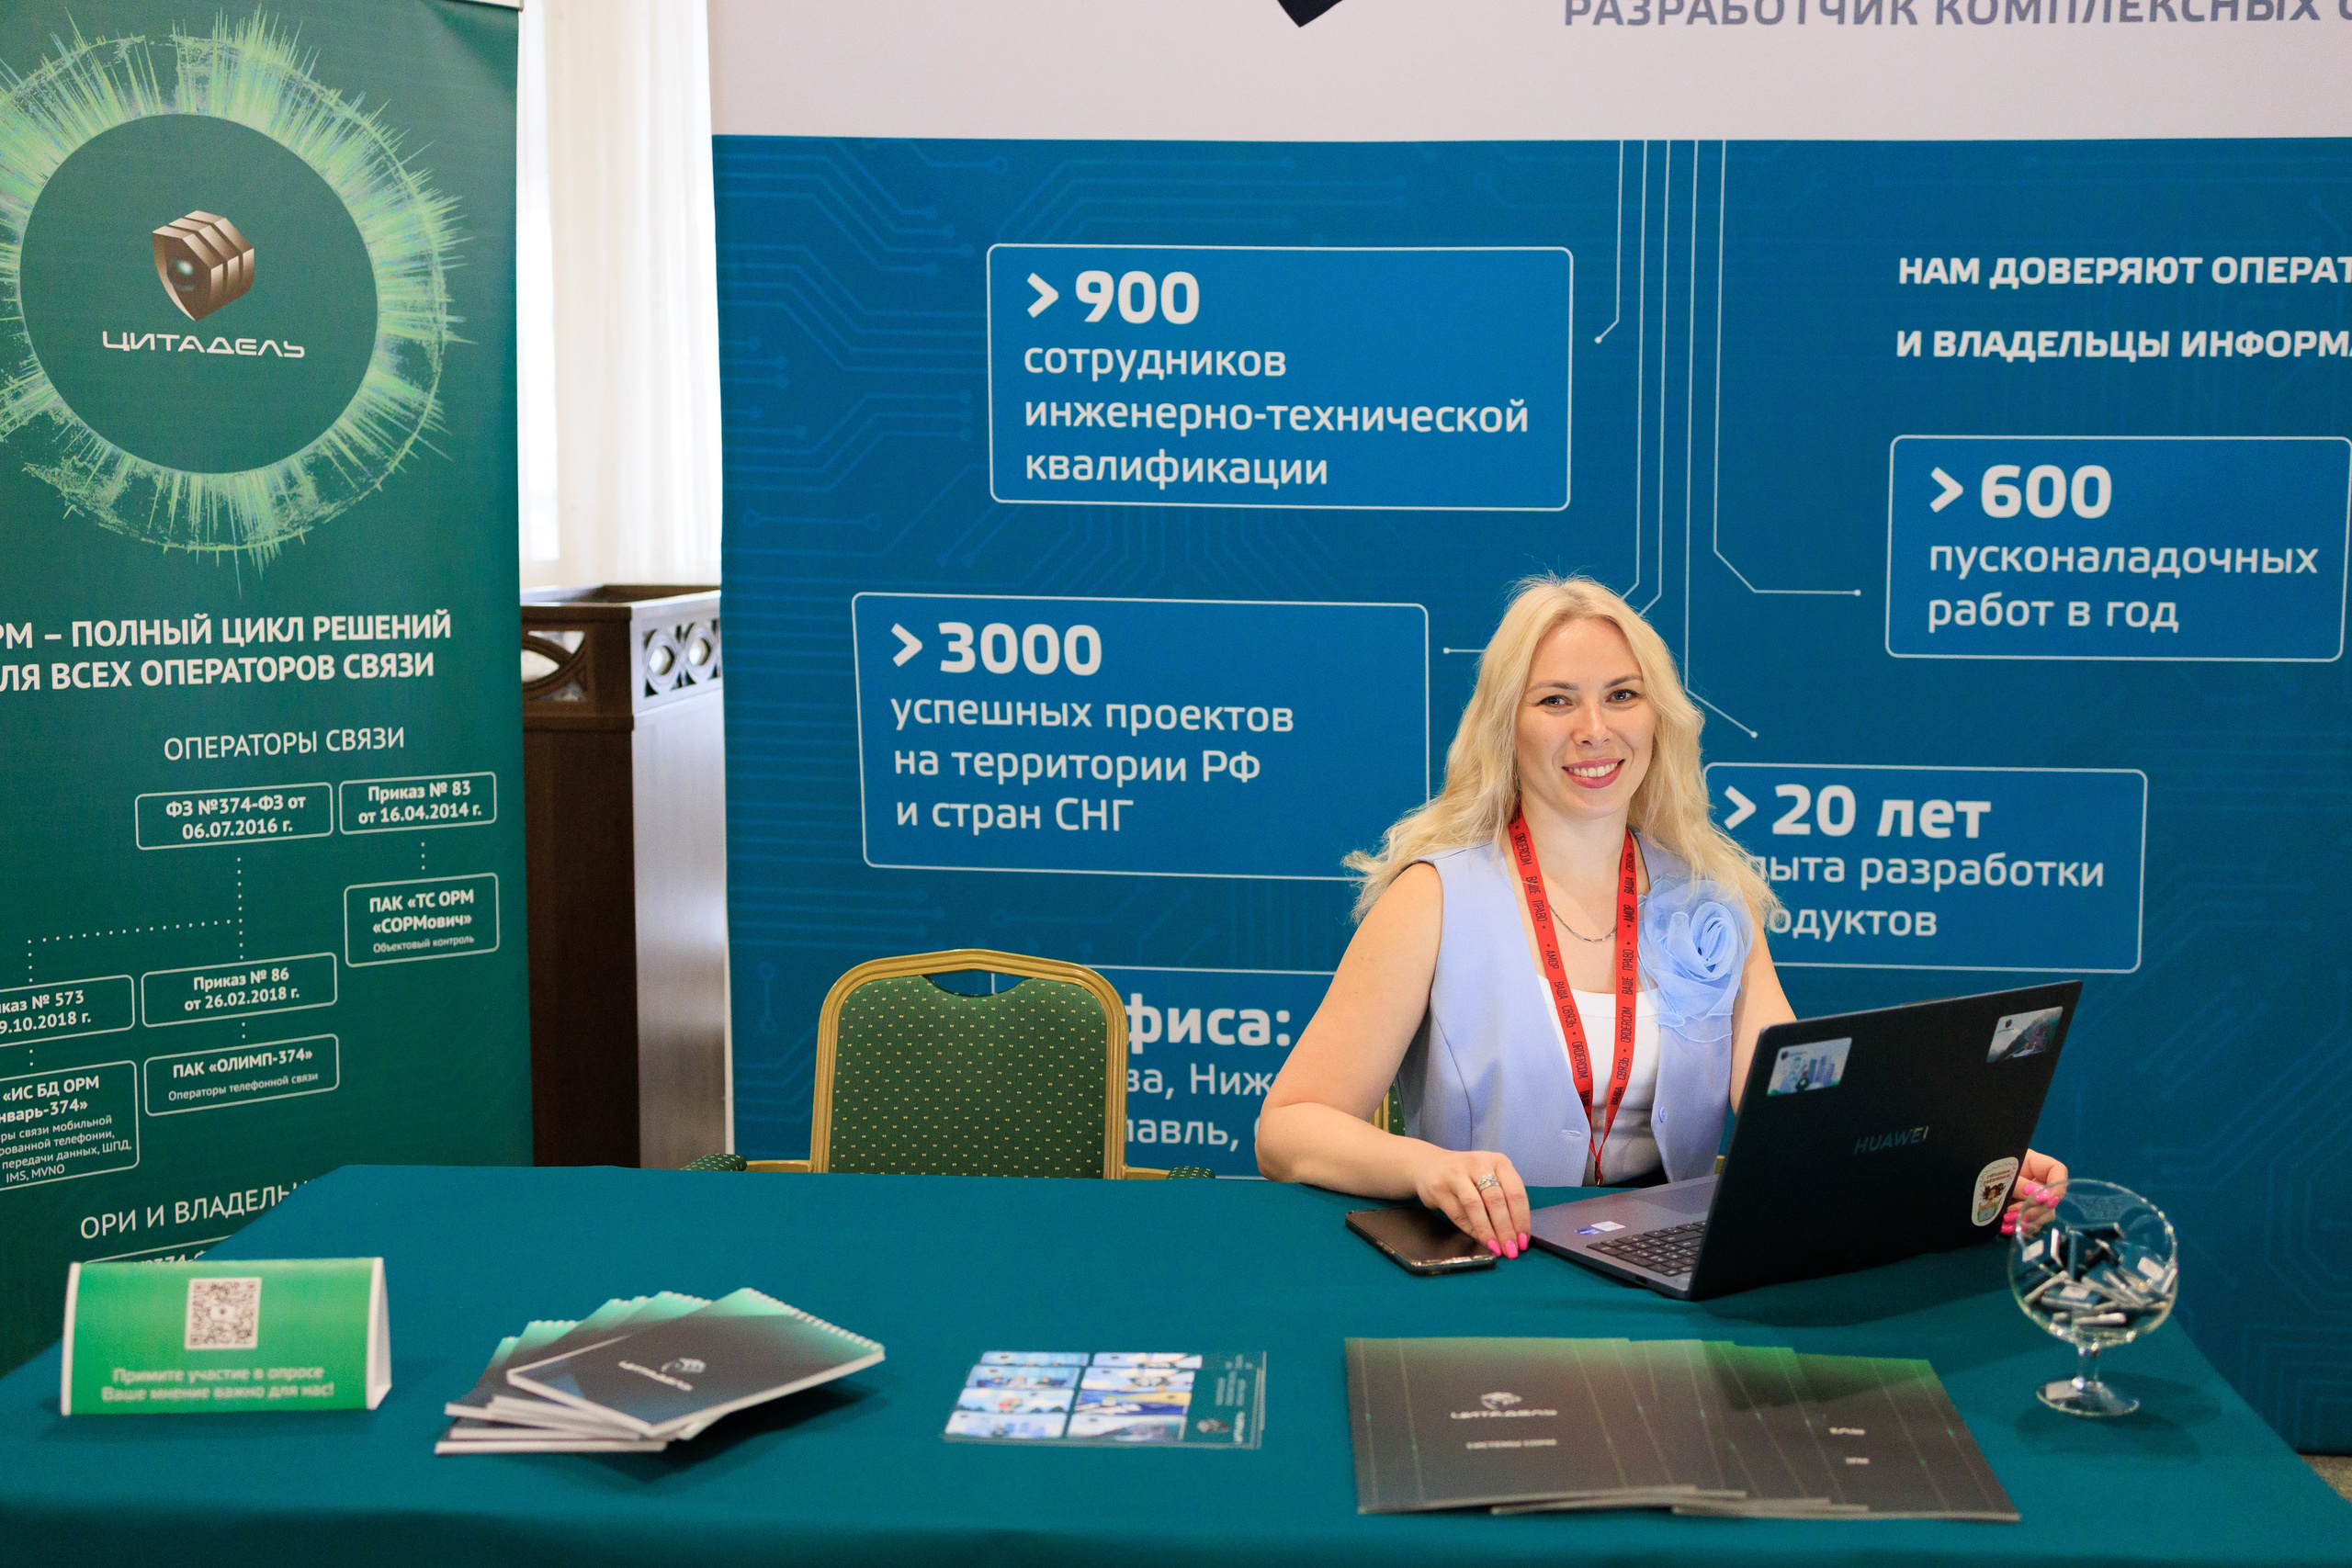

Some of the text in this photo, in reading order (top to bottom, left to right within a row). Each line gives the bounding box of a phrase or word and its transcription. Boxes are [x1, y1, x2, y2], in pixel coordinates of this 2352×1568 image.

[1566, 0, 1917, 26] РАЗРАБОТЧИК
[1936, 0, 2320, 25] КОМПЛЕКСНЫХ
[1900, 258, 1979, 284] НАМ
[1989, 256, 2203, 289] ДОВЕРЯЮТ
[1076, 271, 1199, 324] 900
[103, 331, 304, 357] ЦИТАДЕЛЬ
[1897, 331, 2352, 362] И ВЛАДЕЛЬЦЫ ИНФОРМ
[1024, 348, 1285, 382] сотрудников
[1026, 399, 1527, 436] инженерно-технической
[1027, 449, 1327, 490] квалификации
[1982, 465, 2111, 518] 600
[1930, 546, 2318, 580] пусконаладочных
[1929, 592, 2179, 633] работ в год
[73, 614, 211, 647] ПОЛНЫЙ
[222, 617, 303, 647] ЦИКЛ
[313, 609, 450, 641] РЕШЕНИЙ
[939, 622, 1102, 675] 3000
[51, 661, 132, 689] ВСЕХ
[141, 655, 334, 686] ОПЕРАТОРОВ
[344, 652, 434, 679] СВЯЗИ
[890, 699, 1293, 736] успешных проектов
[164, 727, 403, 761] ОПЕРАТОРЫ СВЯЗИ
[895, 750, 1260, 787] на территории РФ
[166, 795, 306, 818] ФЗ №374-ФЗ от
[368, 781, 470, 804] Приказ № 83
[358, 802, 481, 824] от 16.04.2014 г.
[898, 798, 1134, 835] и стран СНГ
[1772, 784, 1856, 836] 20
[1877, 800, 1991, 838] лет
[183, 818, 292, 840] 06.07.2016 г.
[1624, 876, 1634, 895] ВАША
[1861, 852, 2103, 892] разработки
[370, 889, 473, 912] ПАК «ТС ОРМ
[1532, 900, 1548, 922] ПРАВО
[373, 915, 471, 933] «СОРМович»
[1769, 908, 1937, 942] одуктов
[373, 936, 474, 953] Объектовый контроль
[194, 967, 288, 992] Приказ № 86
[1622, 949, 1634, 996] ВАШЕ ПРАВО
[32, 995, 50, 1009] №
[56, 990, 84, 1006] 573
[185, 987, 300, 1010] от 26.02.2018 г.
[1554, 981, 1575, 1028] ВАША СВЯЗЬ
[82, 1013, 91, 1023] г.
[1125, 993, 1291, 1055] фиса:
[174, 1048, 312, 1077] ПАК «ОЛИМП-374»
[1616, 1056, 1630, 1081] СВЯЗЬ
[3, 1076, 99, 1101] «ИС БД ОРМ
[169, 1073, 318, 1100] Операторы телефонной связи
[19, 1127, 49, 1138] связи
[52, 1115, 111, 1133] мобильной
[54, 1131, 115, 1146] телефонии,
[1854, 1126, 1929, 1155] HUAWEI
[3, 1155, 53, 1169] передачи
[56, 1147, 100, 1161] данных,
[6, 1164, 64, 1182] IMS, MVNO
[81, 1210, 136, 1238] ОРИ
[147, 1205, 164, 1227] И
